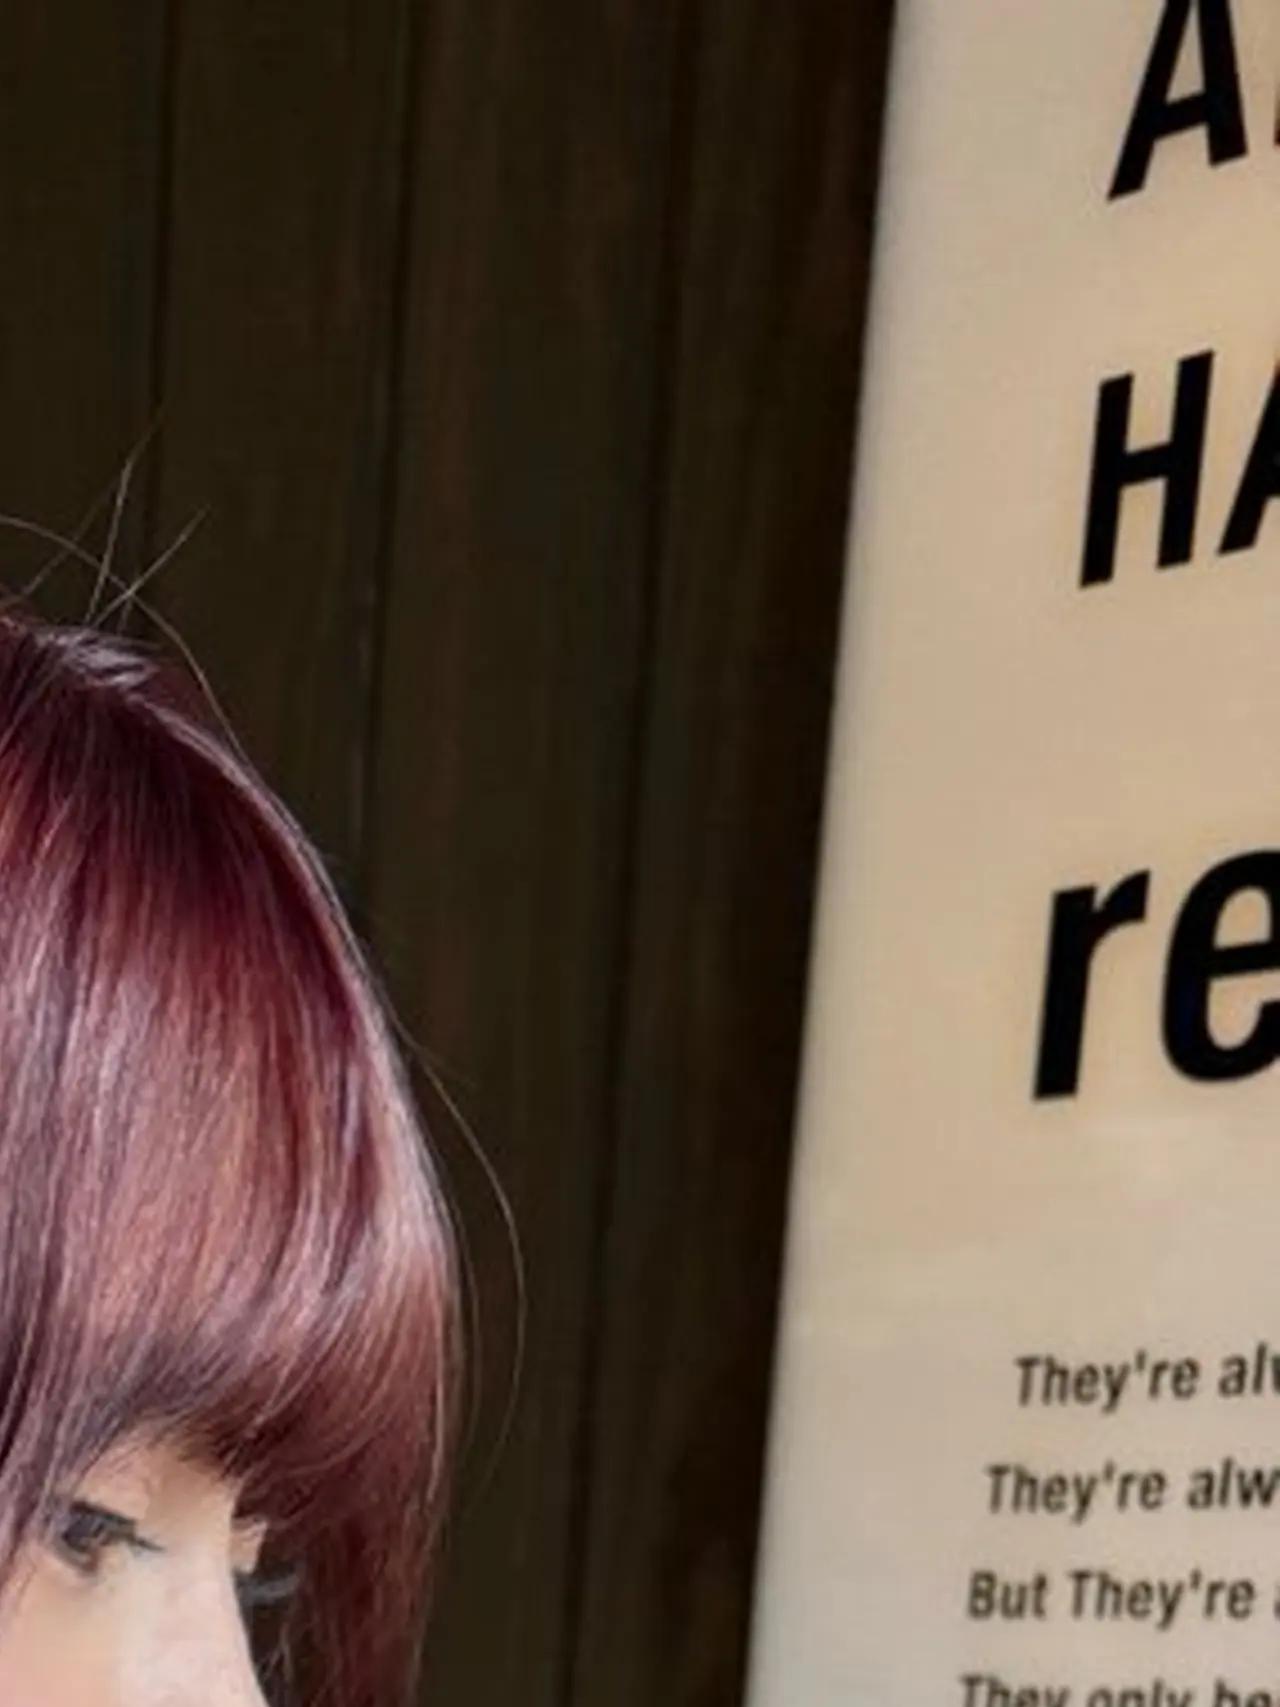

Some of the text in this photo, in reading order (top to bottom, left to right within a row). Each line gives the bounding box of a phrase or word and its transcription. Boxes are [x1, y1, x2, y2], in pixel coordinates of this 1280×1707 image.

[1107, 0, 1280, 200] A
[1015, 1341, 1280, 1416] They're al
[986, 1459, 1167, 1526] They're
[968, 1569, 1048, 1621] But
[1068, 1568, 1255, 1632] They're
